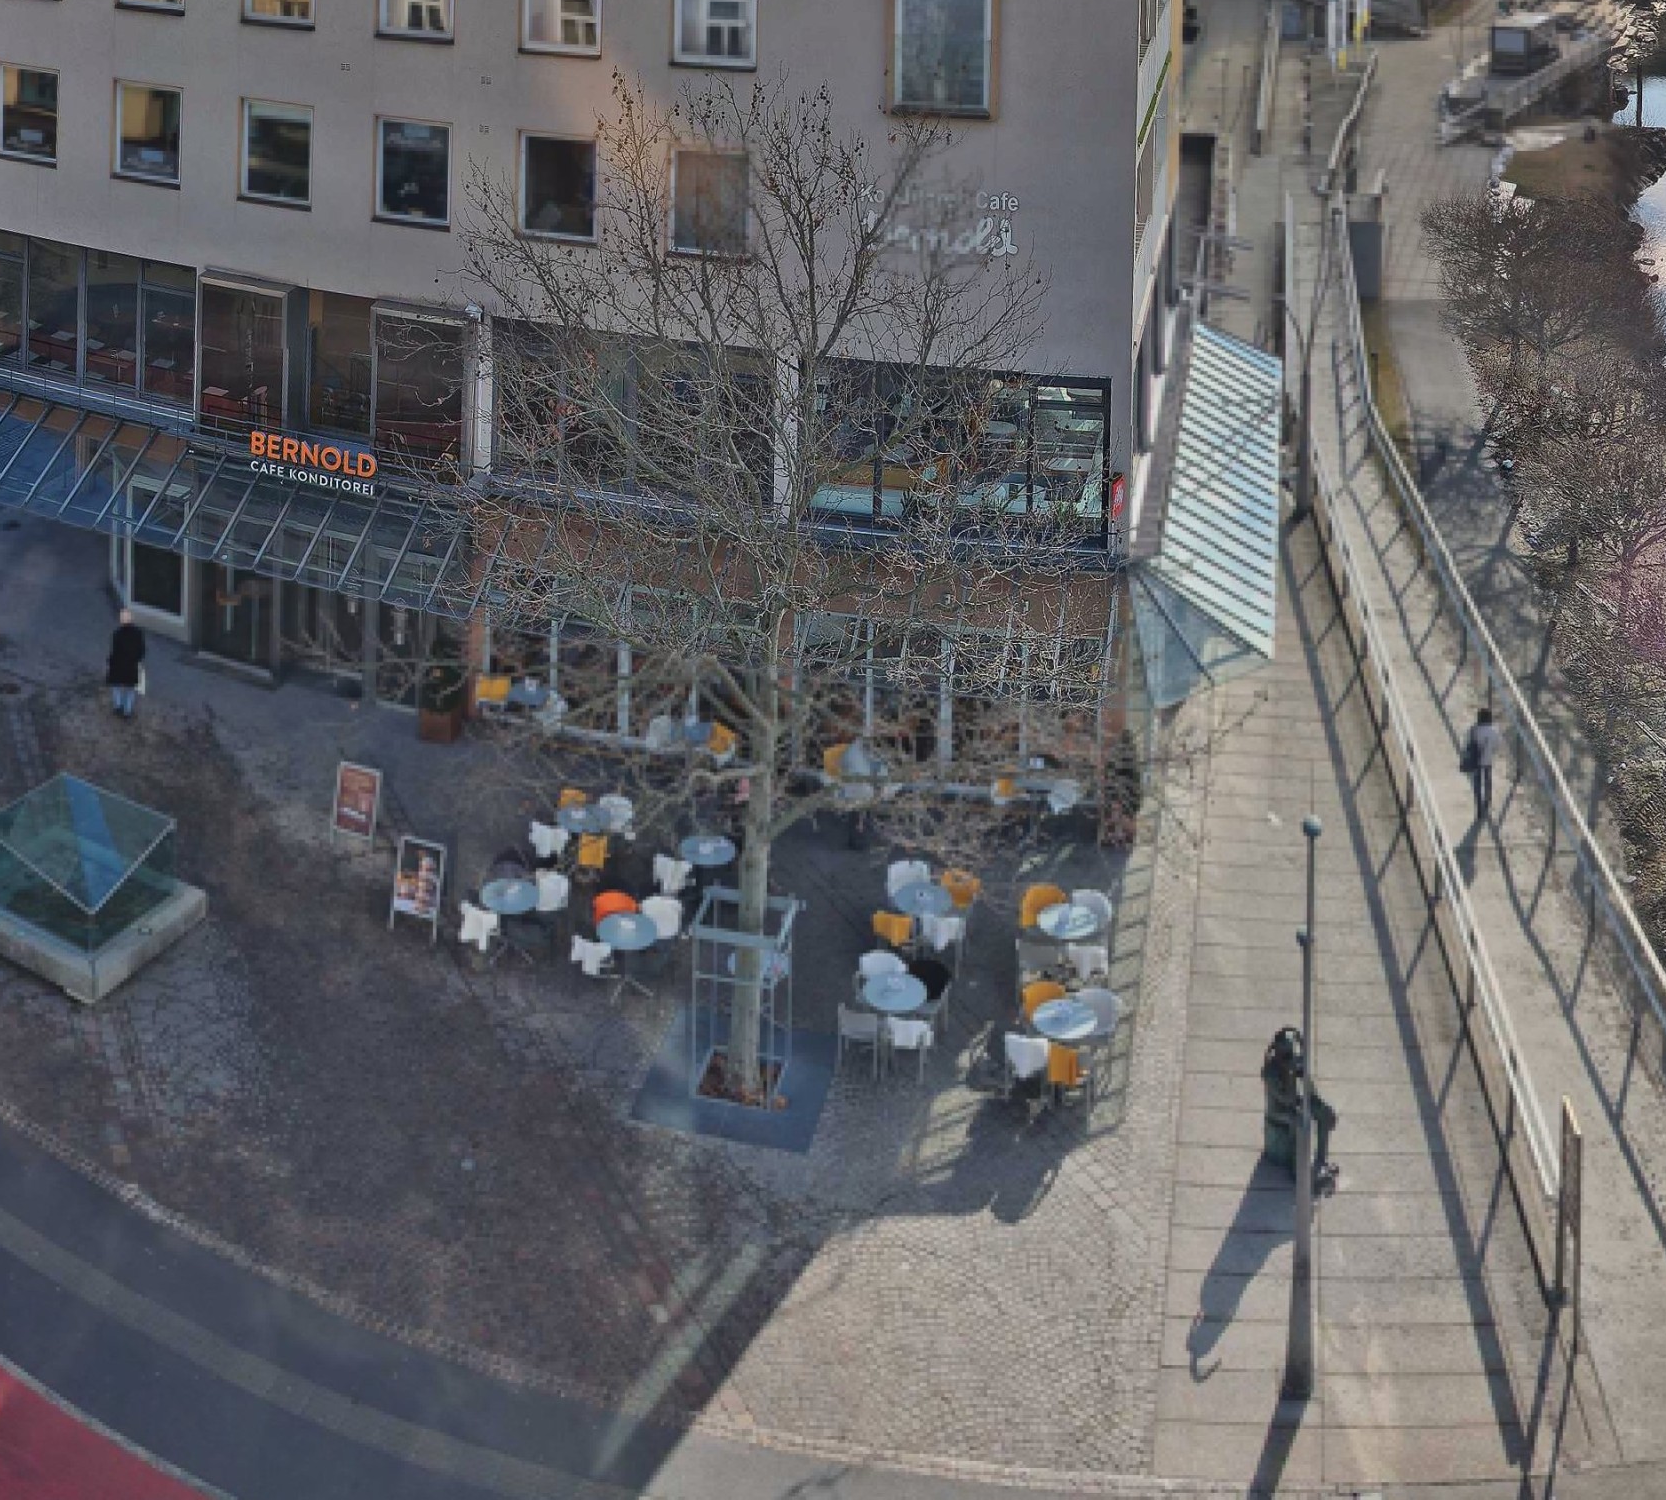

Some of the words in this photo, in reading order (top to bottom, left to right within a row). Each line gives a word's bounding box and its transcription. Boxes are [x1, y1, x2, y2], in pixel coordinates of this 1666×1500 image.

[975, 191, 1020, 212] Cafe
[249, 430, 379, 479] BERNOLD
[250, 459, 285, 478] CAFE
[289, 468, 374, 497] KONDITOREI
